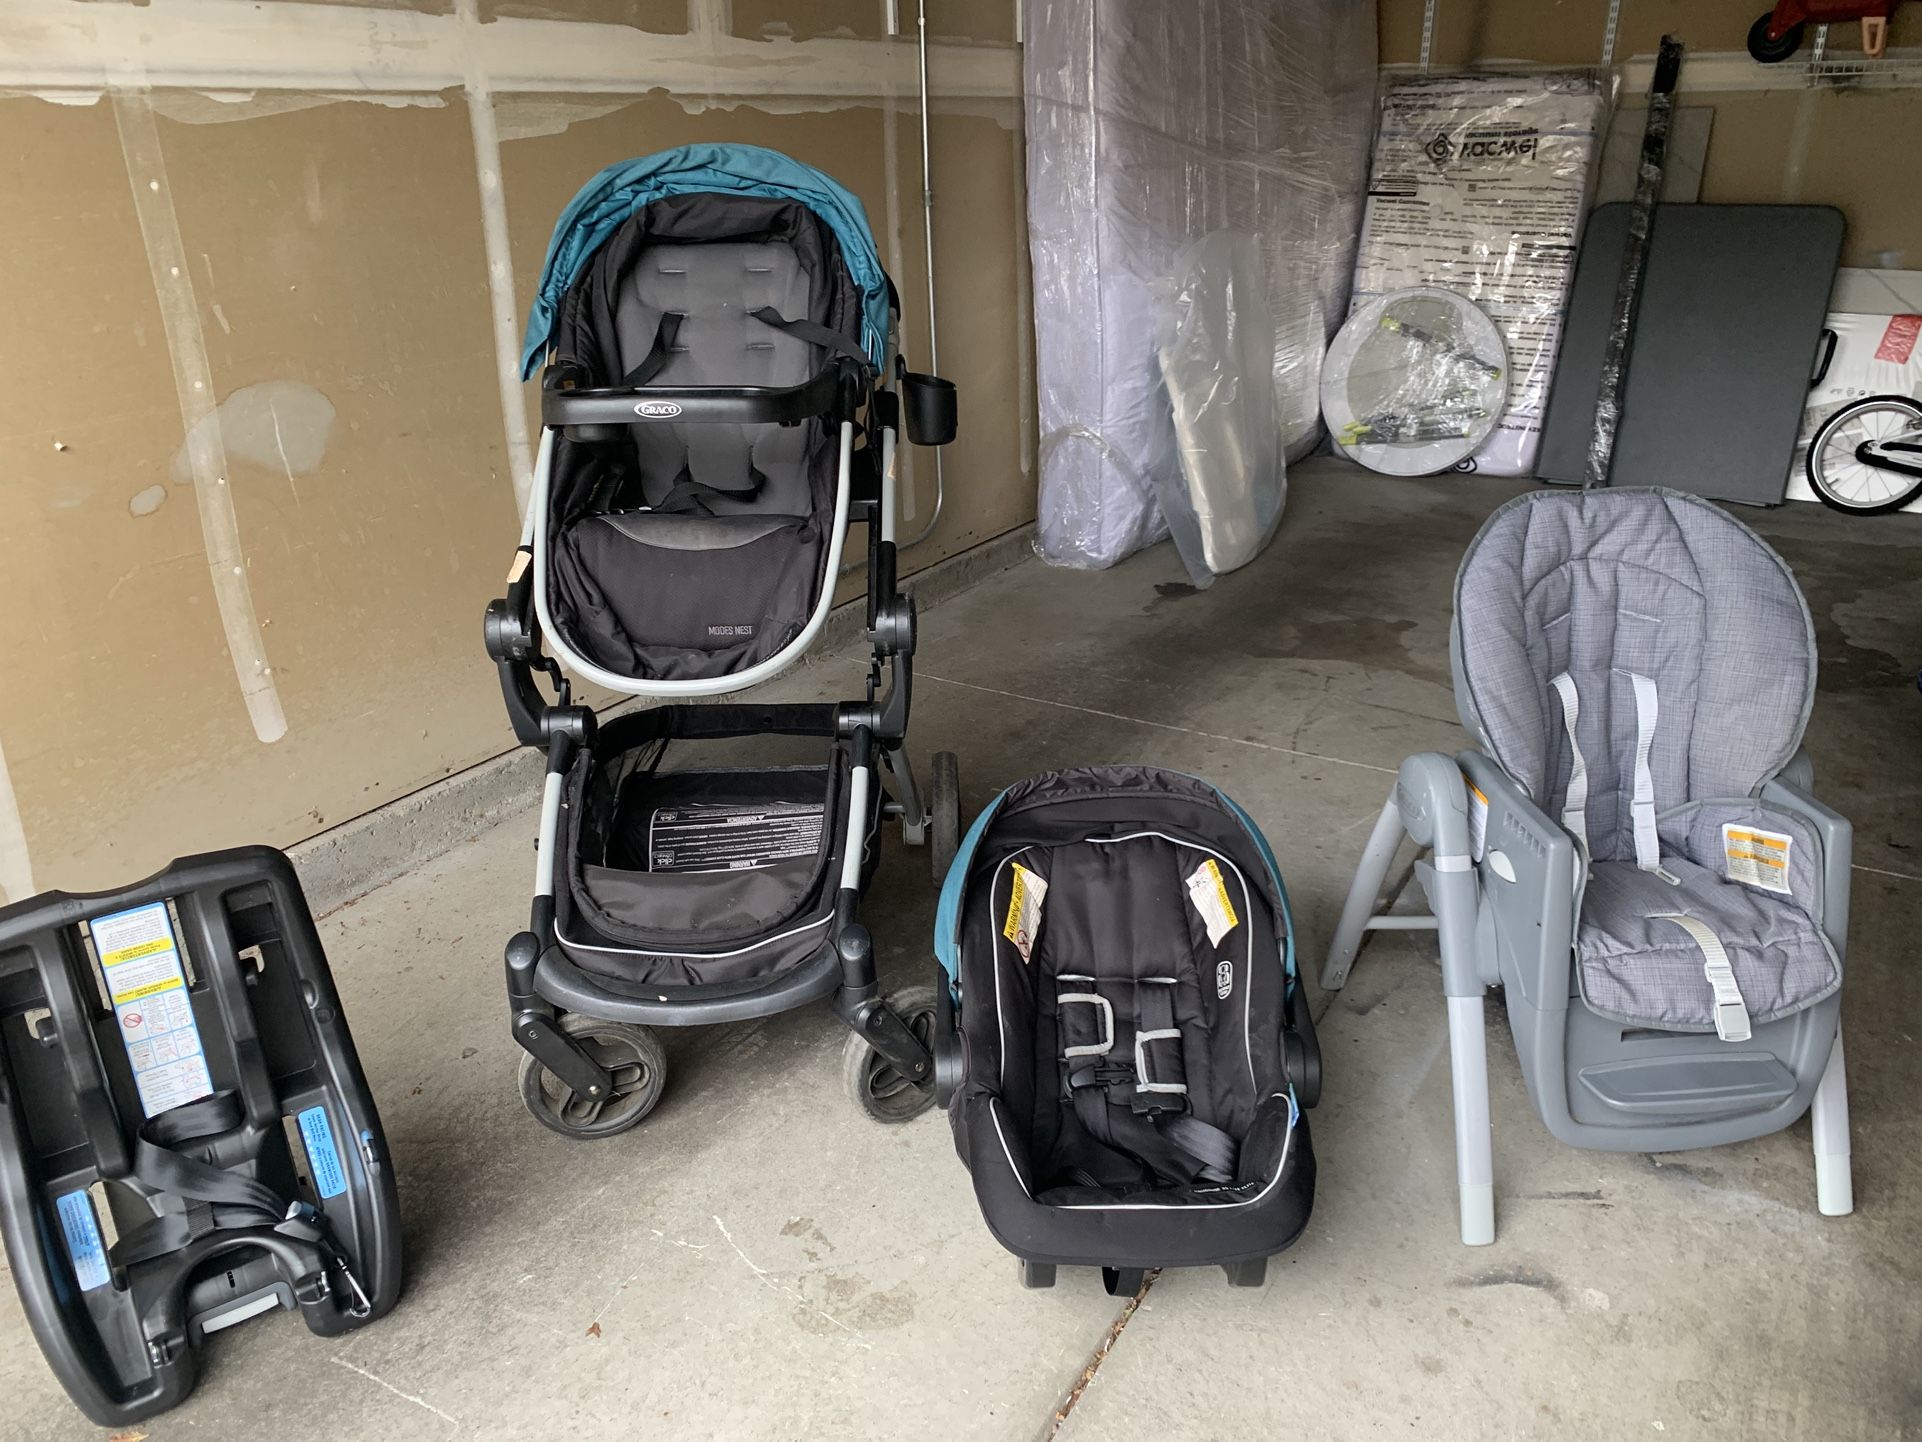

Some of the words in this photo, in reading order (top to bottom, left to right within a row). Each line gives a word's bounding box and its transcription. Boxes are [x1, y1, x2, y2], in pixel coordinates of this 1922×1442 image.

[641, 405, 678, 415] GRACO
[708, 625, 734, 636] MODES
[735, 625, 753, 635] NEST
